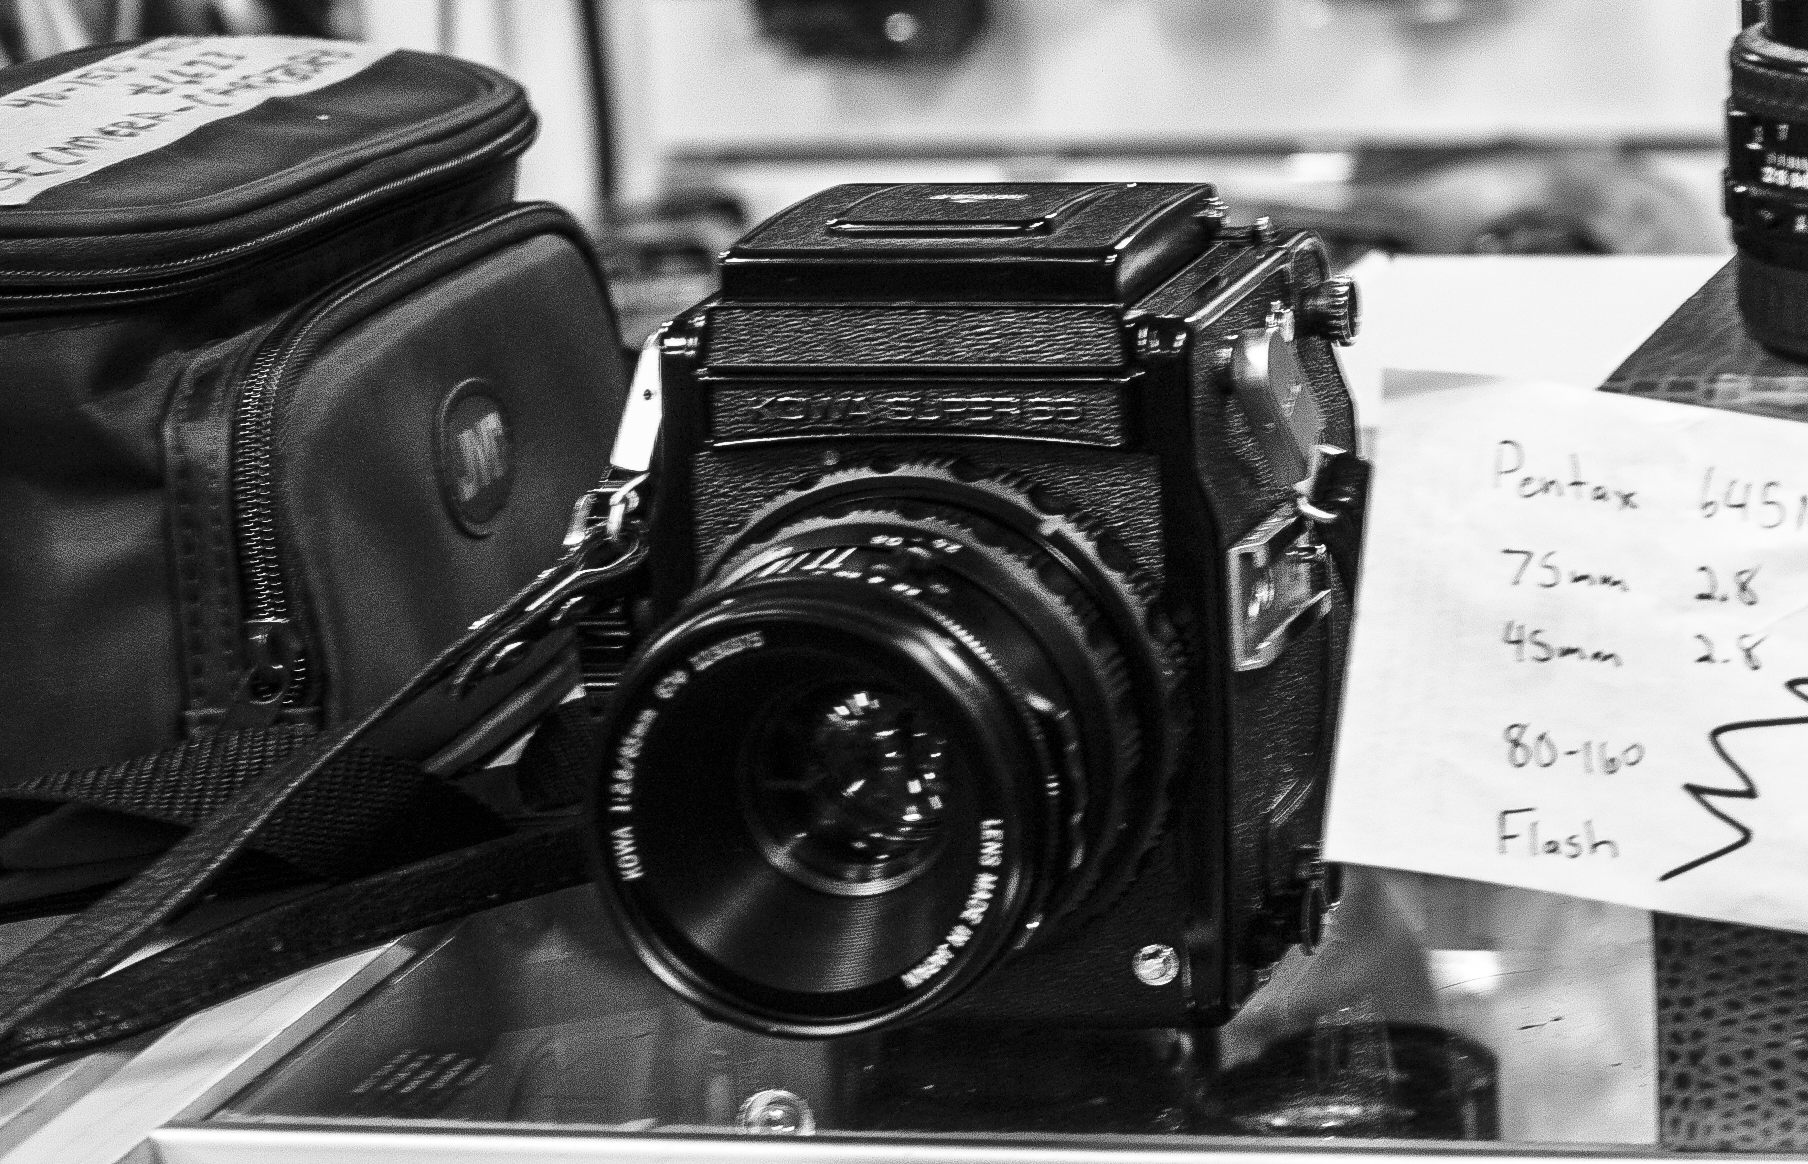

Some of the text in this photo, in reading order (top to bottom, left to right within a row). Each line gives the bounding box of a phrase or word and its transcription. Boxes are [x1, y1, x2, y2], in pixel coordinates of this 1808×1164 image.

[749, 395, 871, 421] KOWA
[886, 395, 1022, 422] SUPER
[1492, 439, 1642, 511] Pentax
[1501, 549, 1764, 607] 75mm 2.8
[1501, 619, 1765, 671] 45mm 2.8
[1503, 722, 1646, 771] 80-160
[610, 825, 646, 881] KOWA
[979, 818, 1005, 868] LENS
[1496, 805, 1621, 861] Flash
